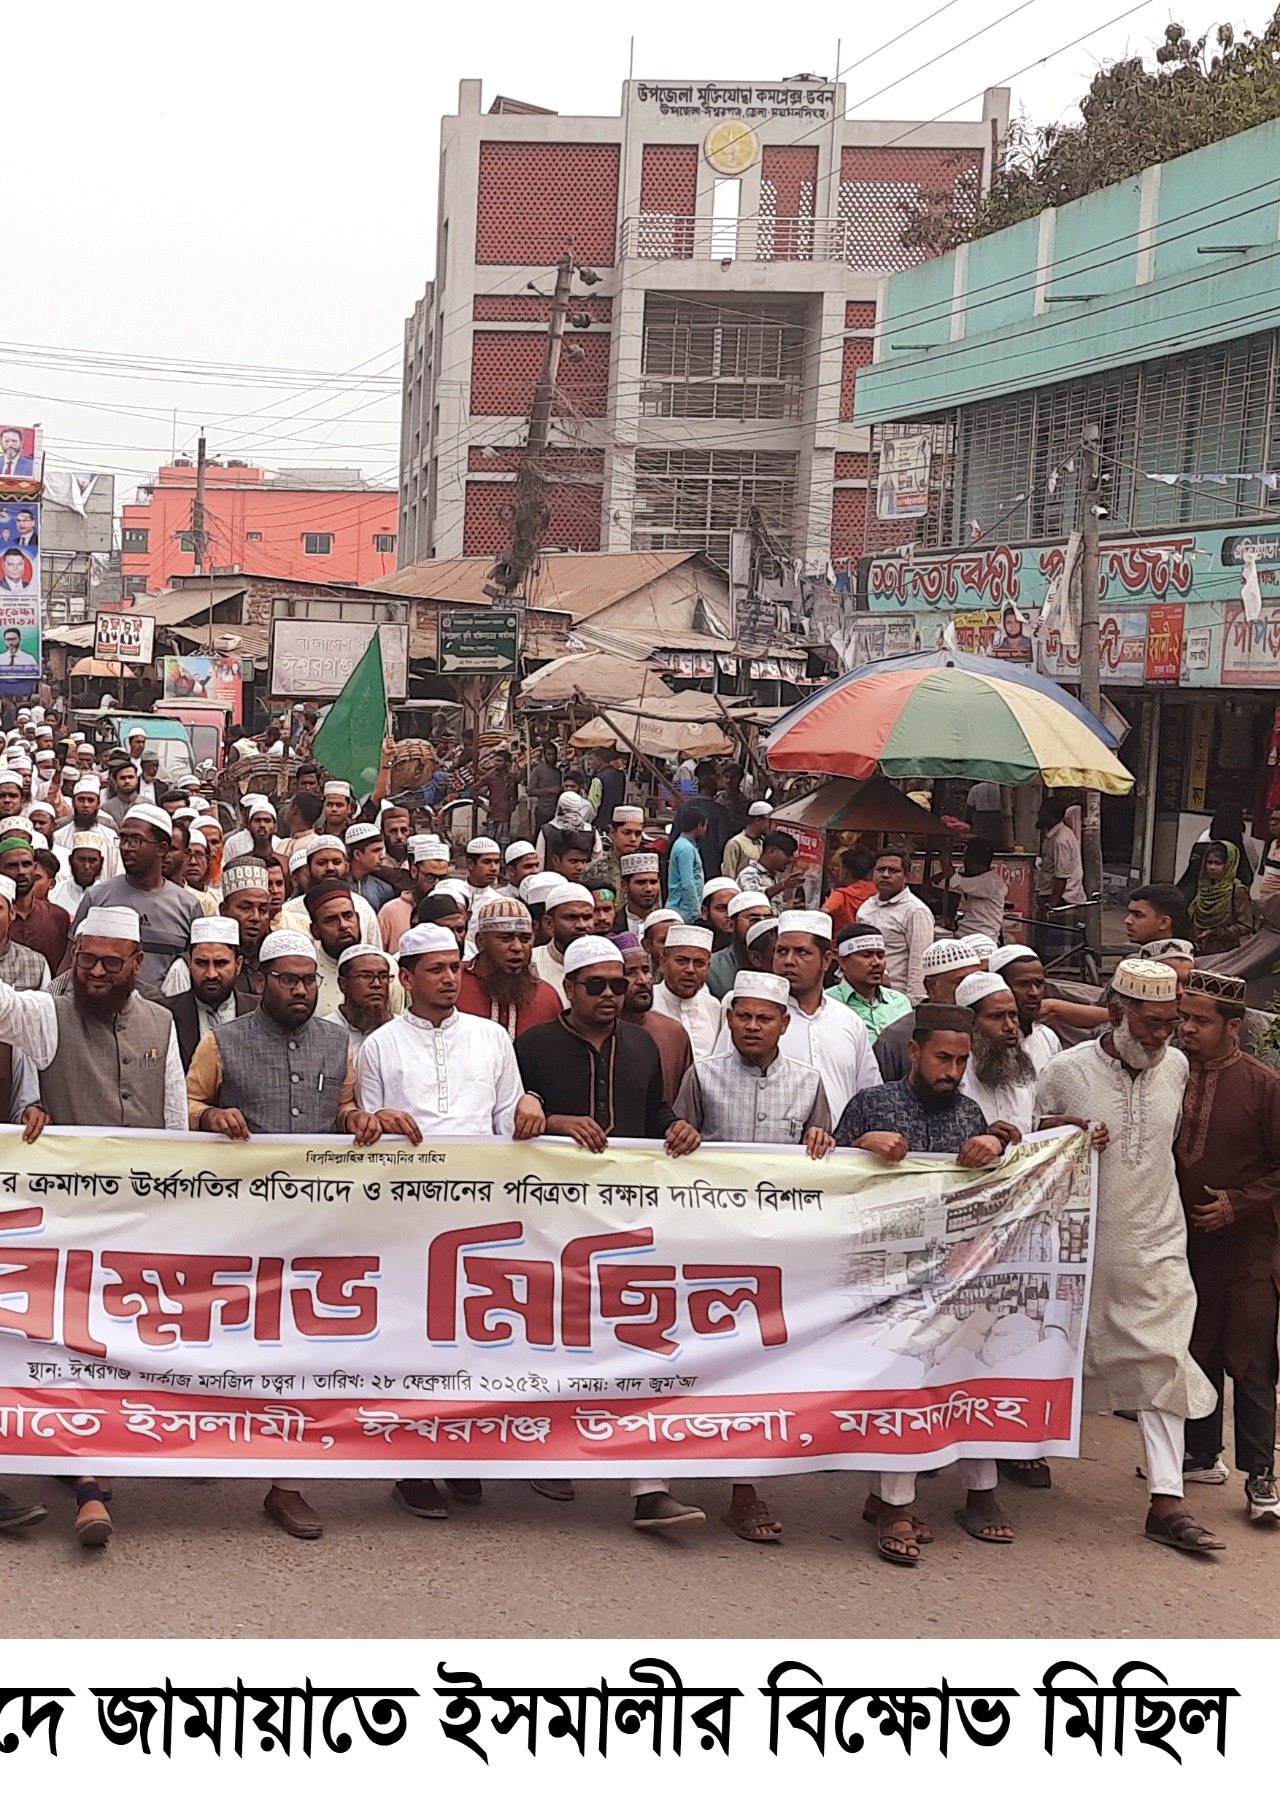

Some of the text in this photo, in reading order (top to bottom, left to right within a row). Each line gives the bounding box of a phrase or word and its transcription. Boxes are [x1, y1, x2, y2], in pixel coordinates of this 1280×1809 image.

[638, 83, 693, 104] উপজেলা
[807, 89, 835, 105] ভবন
[870, 545, 1021, 604] শতাব্দী
[27, 1172, 123, 1196] ক্রমাগত
[249, 1171, 357, 1203] প্রতিবাদে
[363, 1186, 382, 1202] ও
[390, 1179, 495, 1204] রমজানের
[503, 1174, 590, 1206] পবিত্রতা
[597, 1182, 660, 1209] রক্ষার
[667, 1178, 749, 1209] দাবিতে
[756, 1179, 824, 1212] বিশাল
[427, 1221, 790, 1356] মিছিল
[27, 1361, 62, 1381] স্থান:
[198, 1370, 255, 1391] মসজিদ
[313, 1370, 364, 1390] তারিখ:
[371, 1374, 396, 1390] ২৮
[479, 1371, 551, 1393] ২০২৫ইং
[568, 1376, 608, 1393] সময়:
[615, 1376, 645, 1393] বাদ
[120, 1398, 334, 1449] ইসলামী,
[355, 1406, 552, 1445] ঈশ্বরগঞ্জ
[575, 1406, 814, 1446] উপজেলা,
[833, 1393, 1030, 1436] ময়মনসিংহ
